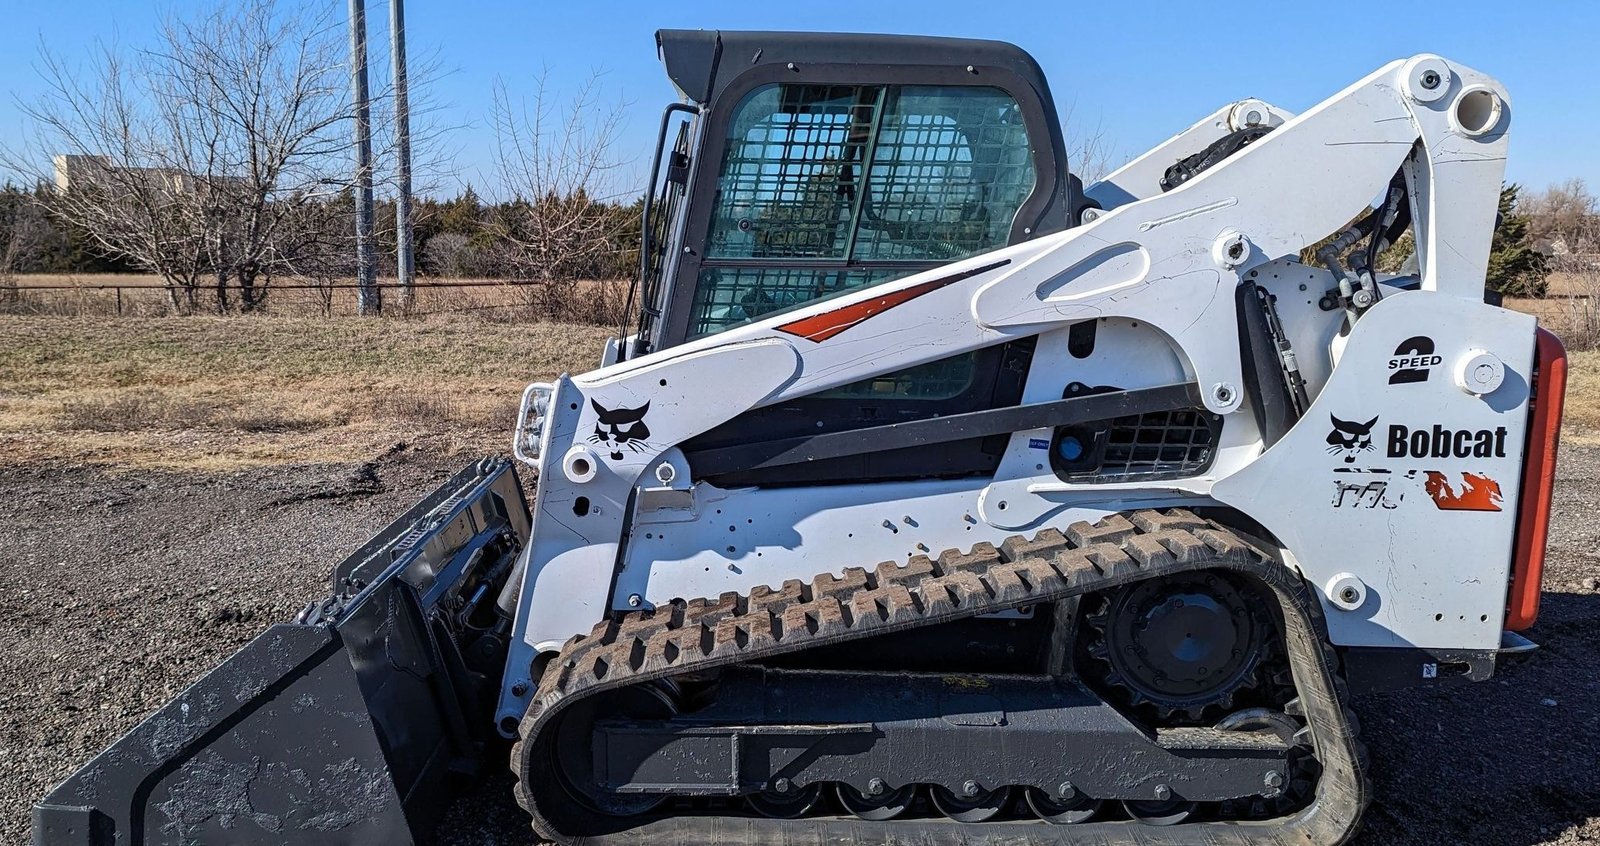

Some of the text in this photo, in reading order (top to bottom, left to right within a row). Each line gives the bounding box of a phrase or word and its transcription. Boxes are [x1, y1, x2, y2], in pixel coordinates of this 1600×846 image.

[1388, 335, 1442, 385] 2 SPEED
[1387, 424, 1507, 458] Bobcat
